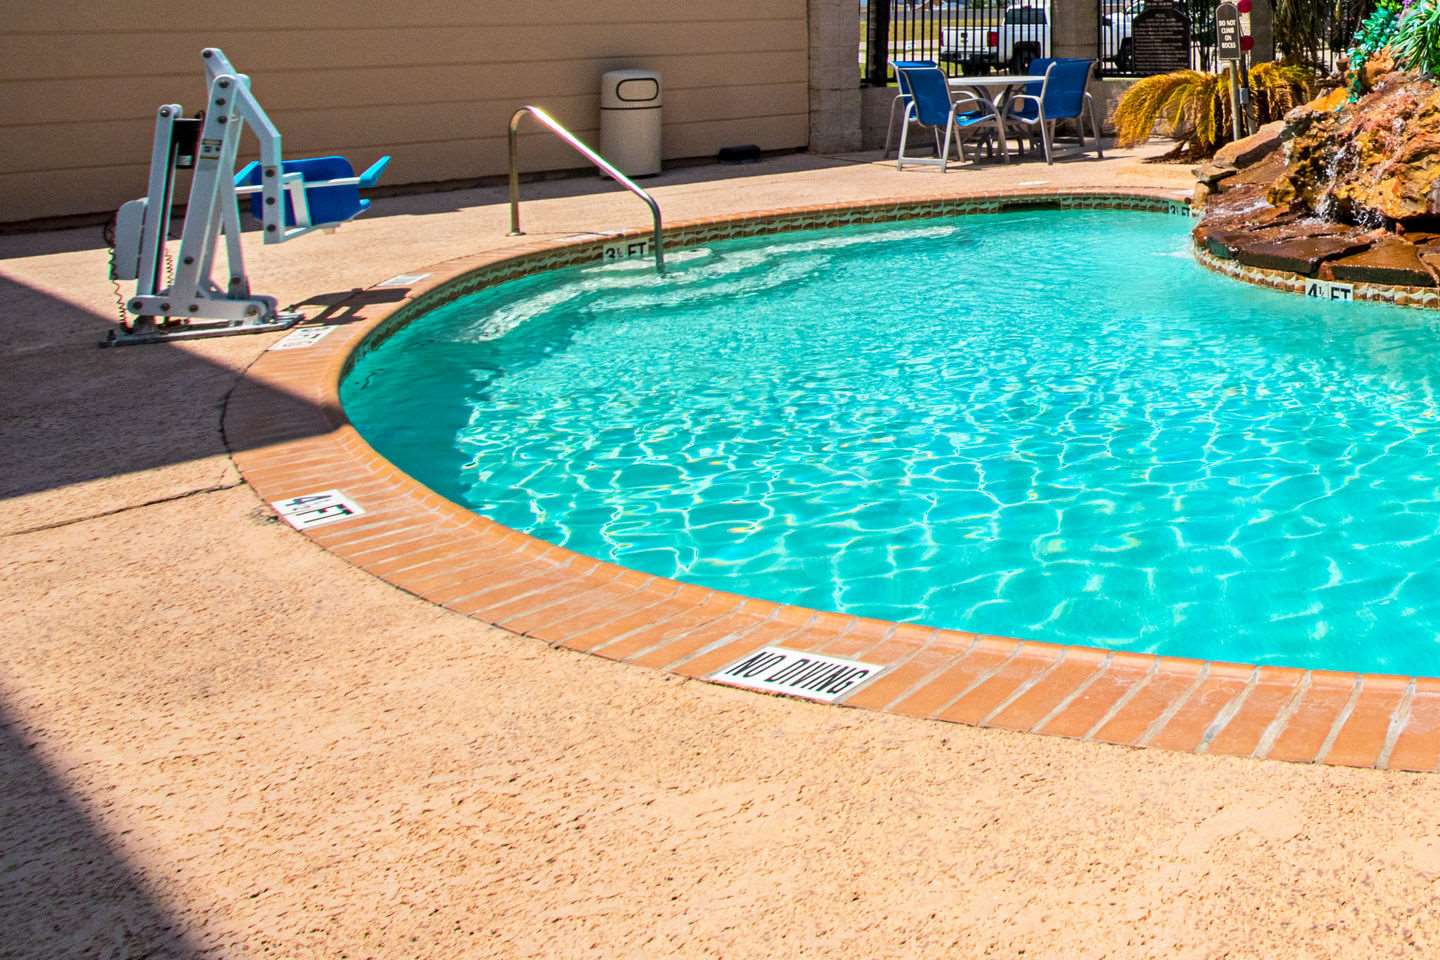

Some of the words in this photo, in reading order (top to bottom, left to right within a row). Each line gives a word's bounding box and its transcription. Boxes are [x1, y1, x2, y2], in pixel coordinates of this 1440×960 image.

[627, 242, 648, 257] FT
[1330, 286, 1352, 301] FT
[295, 503, 354, 524] FT
[725, 651, 787, 678] NO
[763, 658, 870, 695] DIVING
